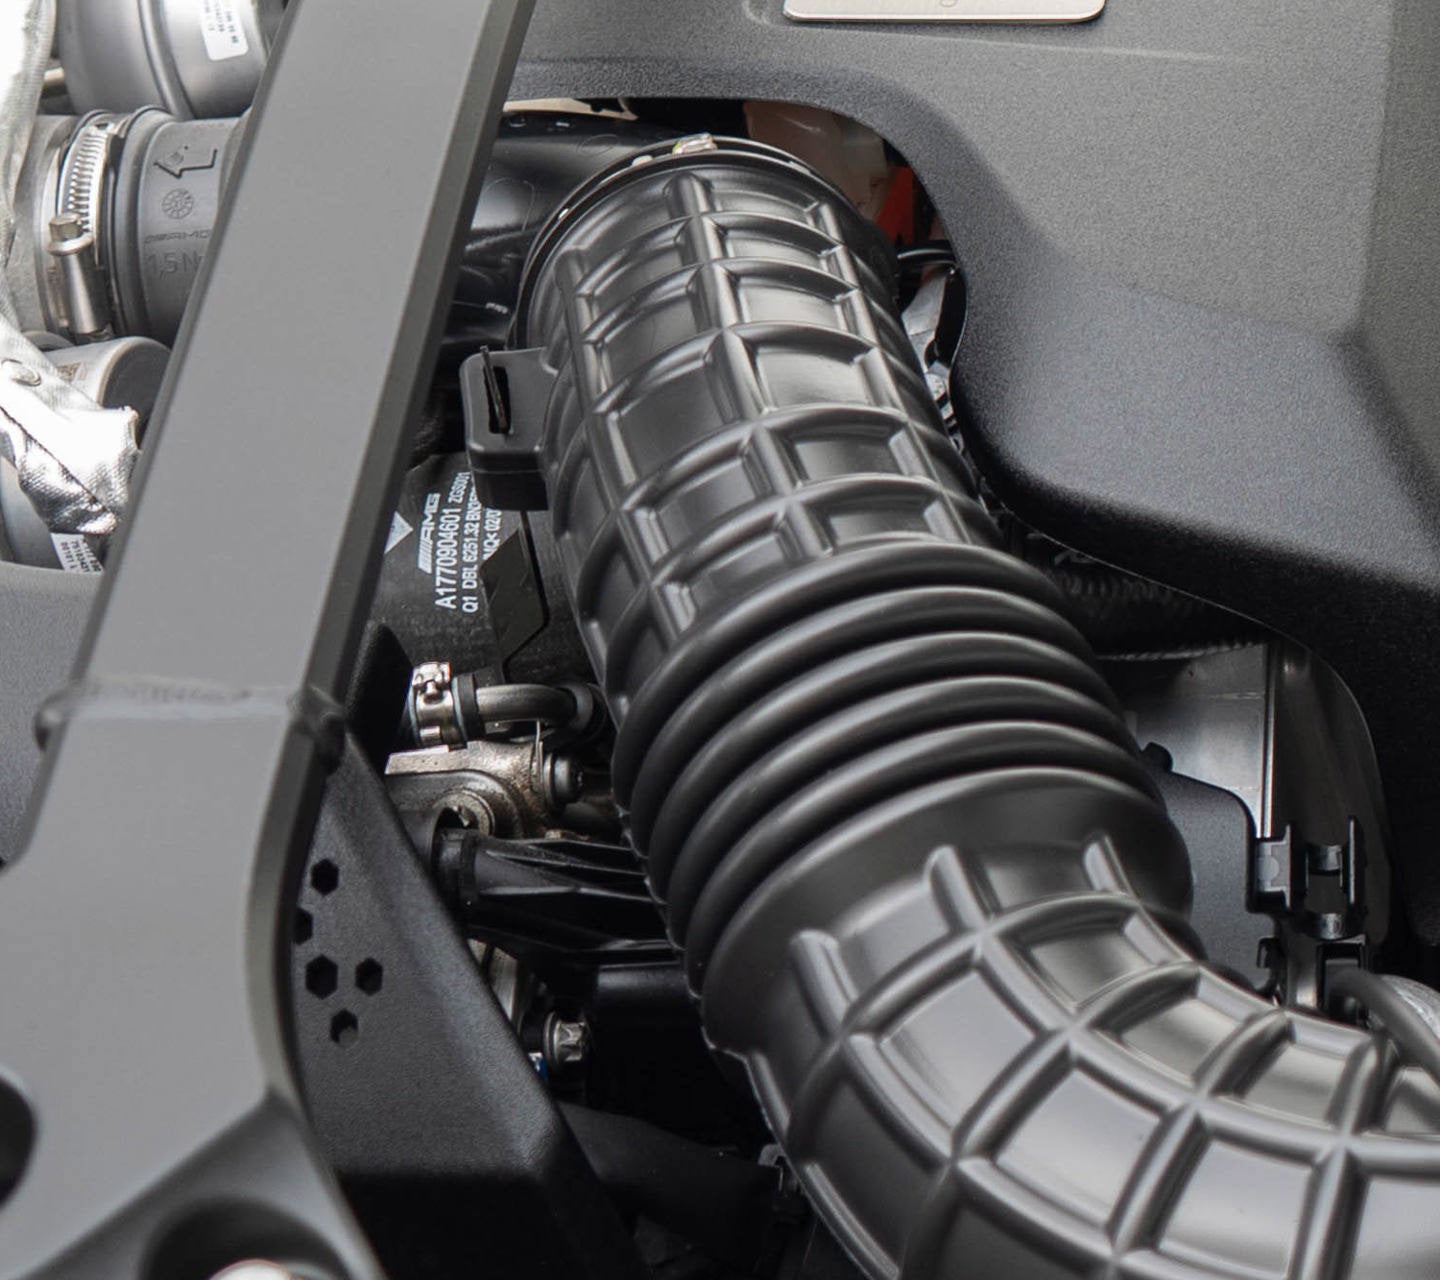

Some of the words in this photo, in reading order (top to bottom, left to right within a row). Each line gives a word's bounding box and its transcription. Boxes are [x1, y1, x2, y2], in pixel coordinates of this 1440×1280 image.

[462, 521, 480, 562] 6251.32
[435, 508, 462, 609] A1770904601
[462, 564, 478, 590] DBL
[462, 596, 478, 613] Q1
